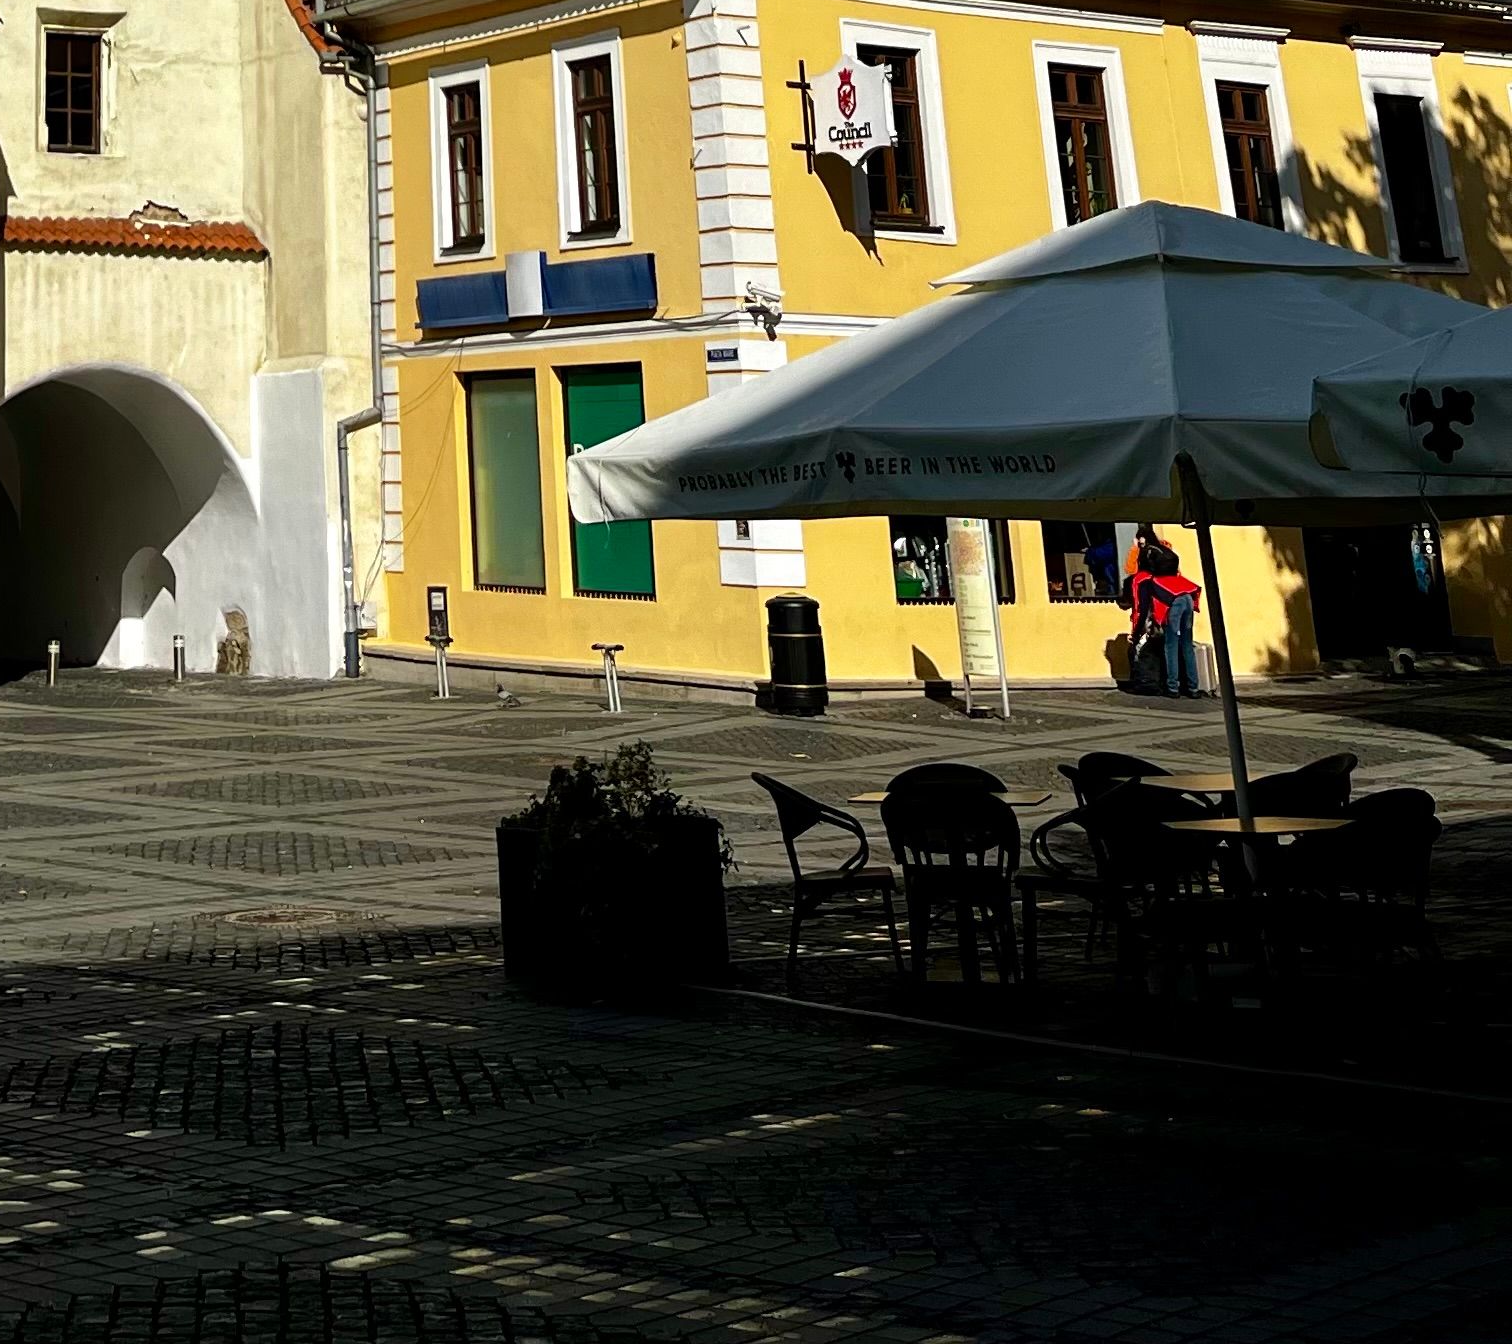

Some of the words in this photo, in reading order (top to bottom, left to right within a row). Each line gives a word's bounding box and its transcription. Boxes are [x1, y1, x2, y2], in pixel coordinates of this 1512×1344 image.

[829, 122, 872, 142] Council
[678, 469, 755, 493] PROBABLY
[758, 466, 788, 485] THE
[793, 461, 827, 482] BEST
[864, 457, 912, 475] BEER
[920, 456, 941, 475] IN
[945, 456, 983, 475] THE
[987, 454, 1057, 474] WORLD
